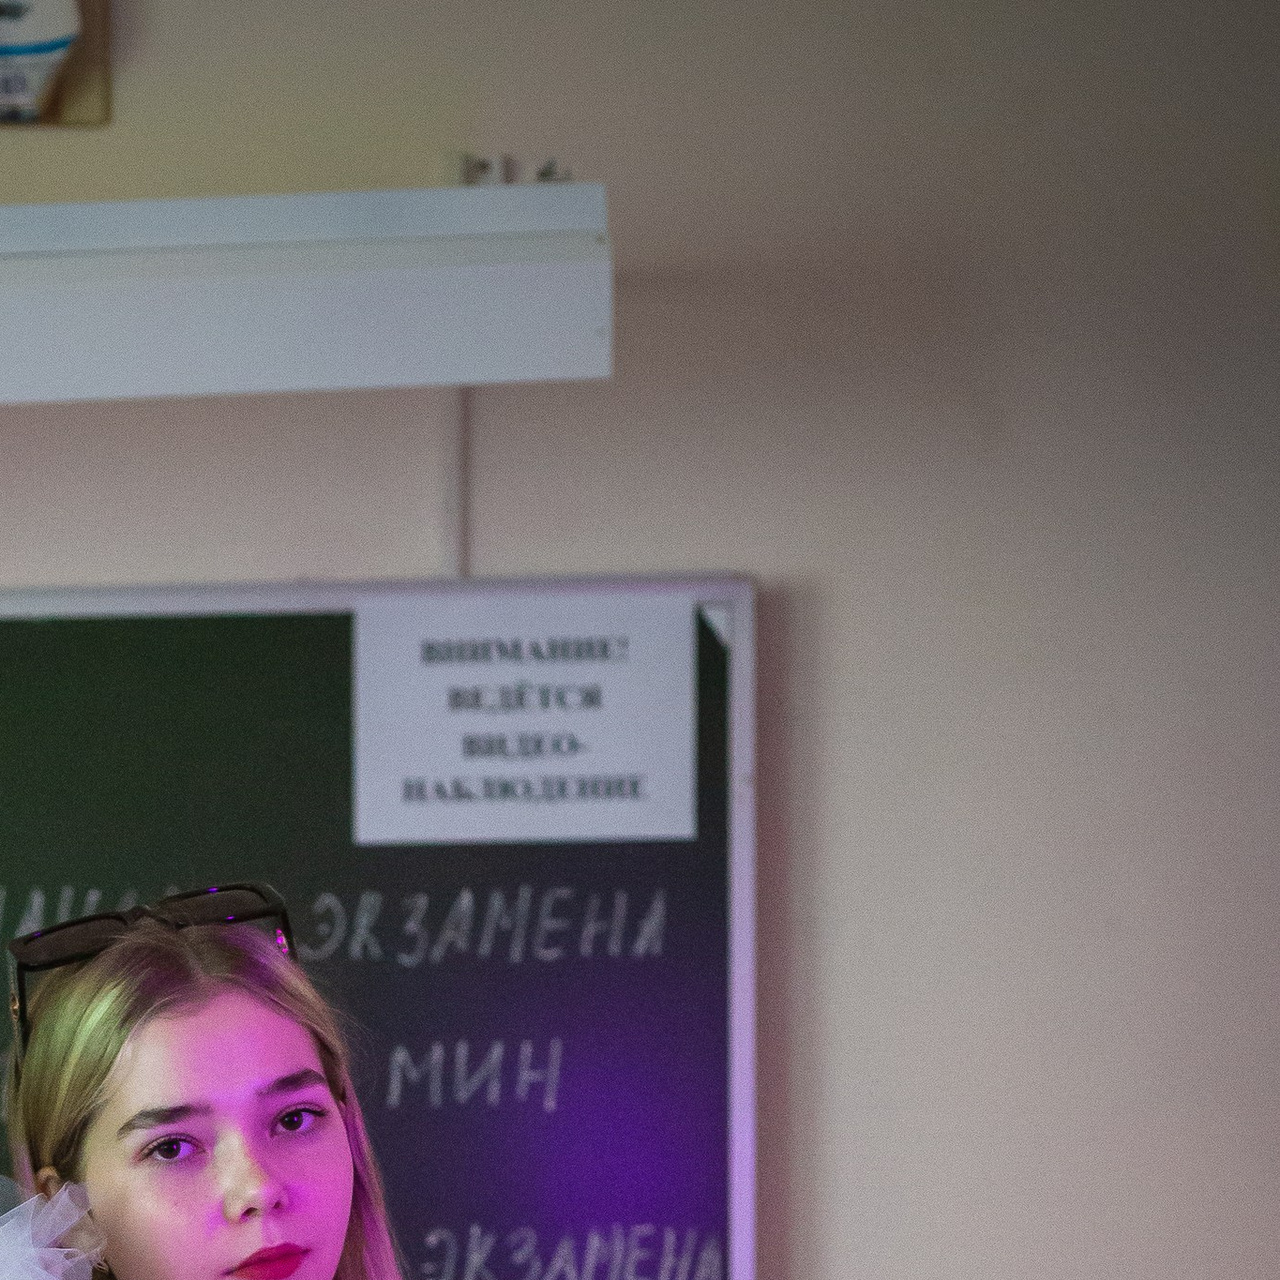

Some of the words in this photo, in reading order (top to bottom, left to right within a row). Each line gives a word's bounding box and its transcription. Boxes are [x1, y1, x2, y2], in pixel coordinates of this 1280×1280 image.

[420, 636, 628, 664] ВНИМАНИЕ!
[401, 774, 646, 802] НАБЛЮДЕНИЕ
[298, 885, 669, 969] ЭКЗАМЕНА
[385, 1036, 563, 1113] МИН
